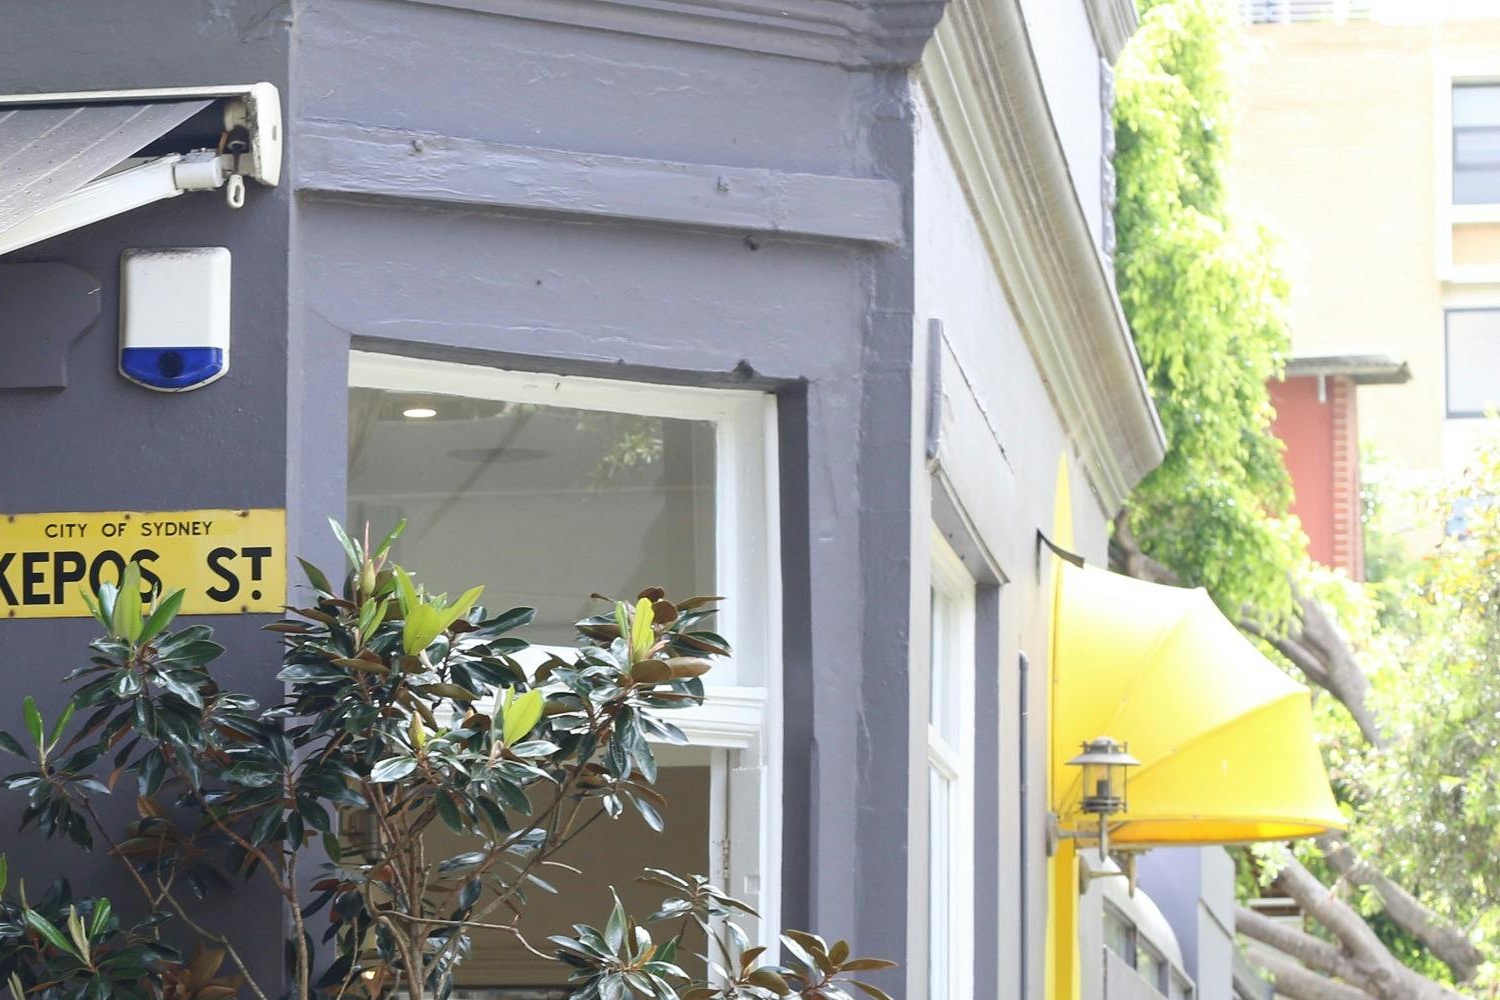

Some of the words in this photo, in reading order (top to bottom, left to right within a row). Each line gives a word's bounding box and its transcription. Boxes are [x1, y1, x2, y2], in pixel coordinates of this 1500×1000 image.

[44, 523, 88, 538] CITY
[101, 522, 128, 538] OF
[141, 521, 213, 536] SYDNEY
